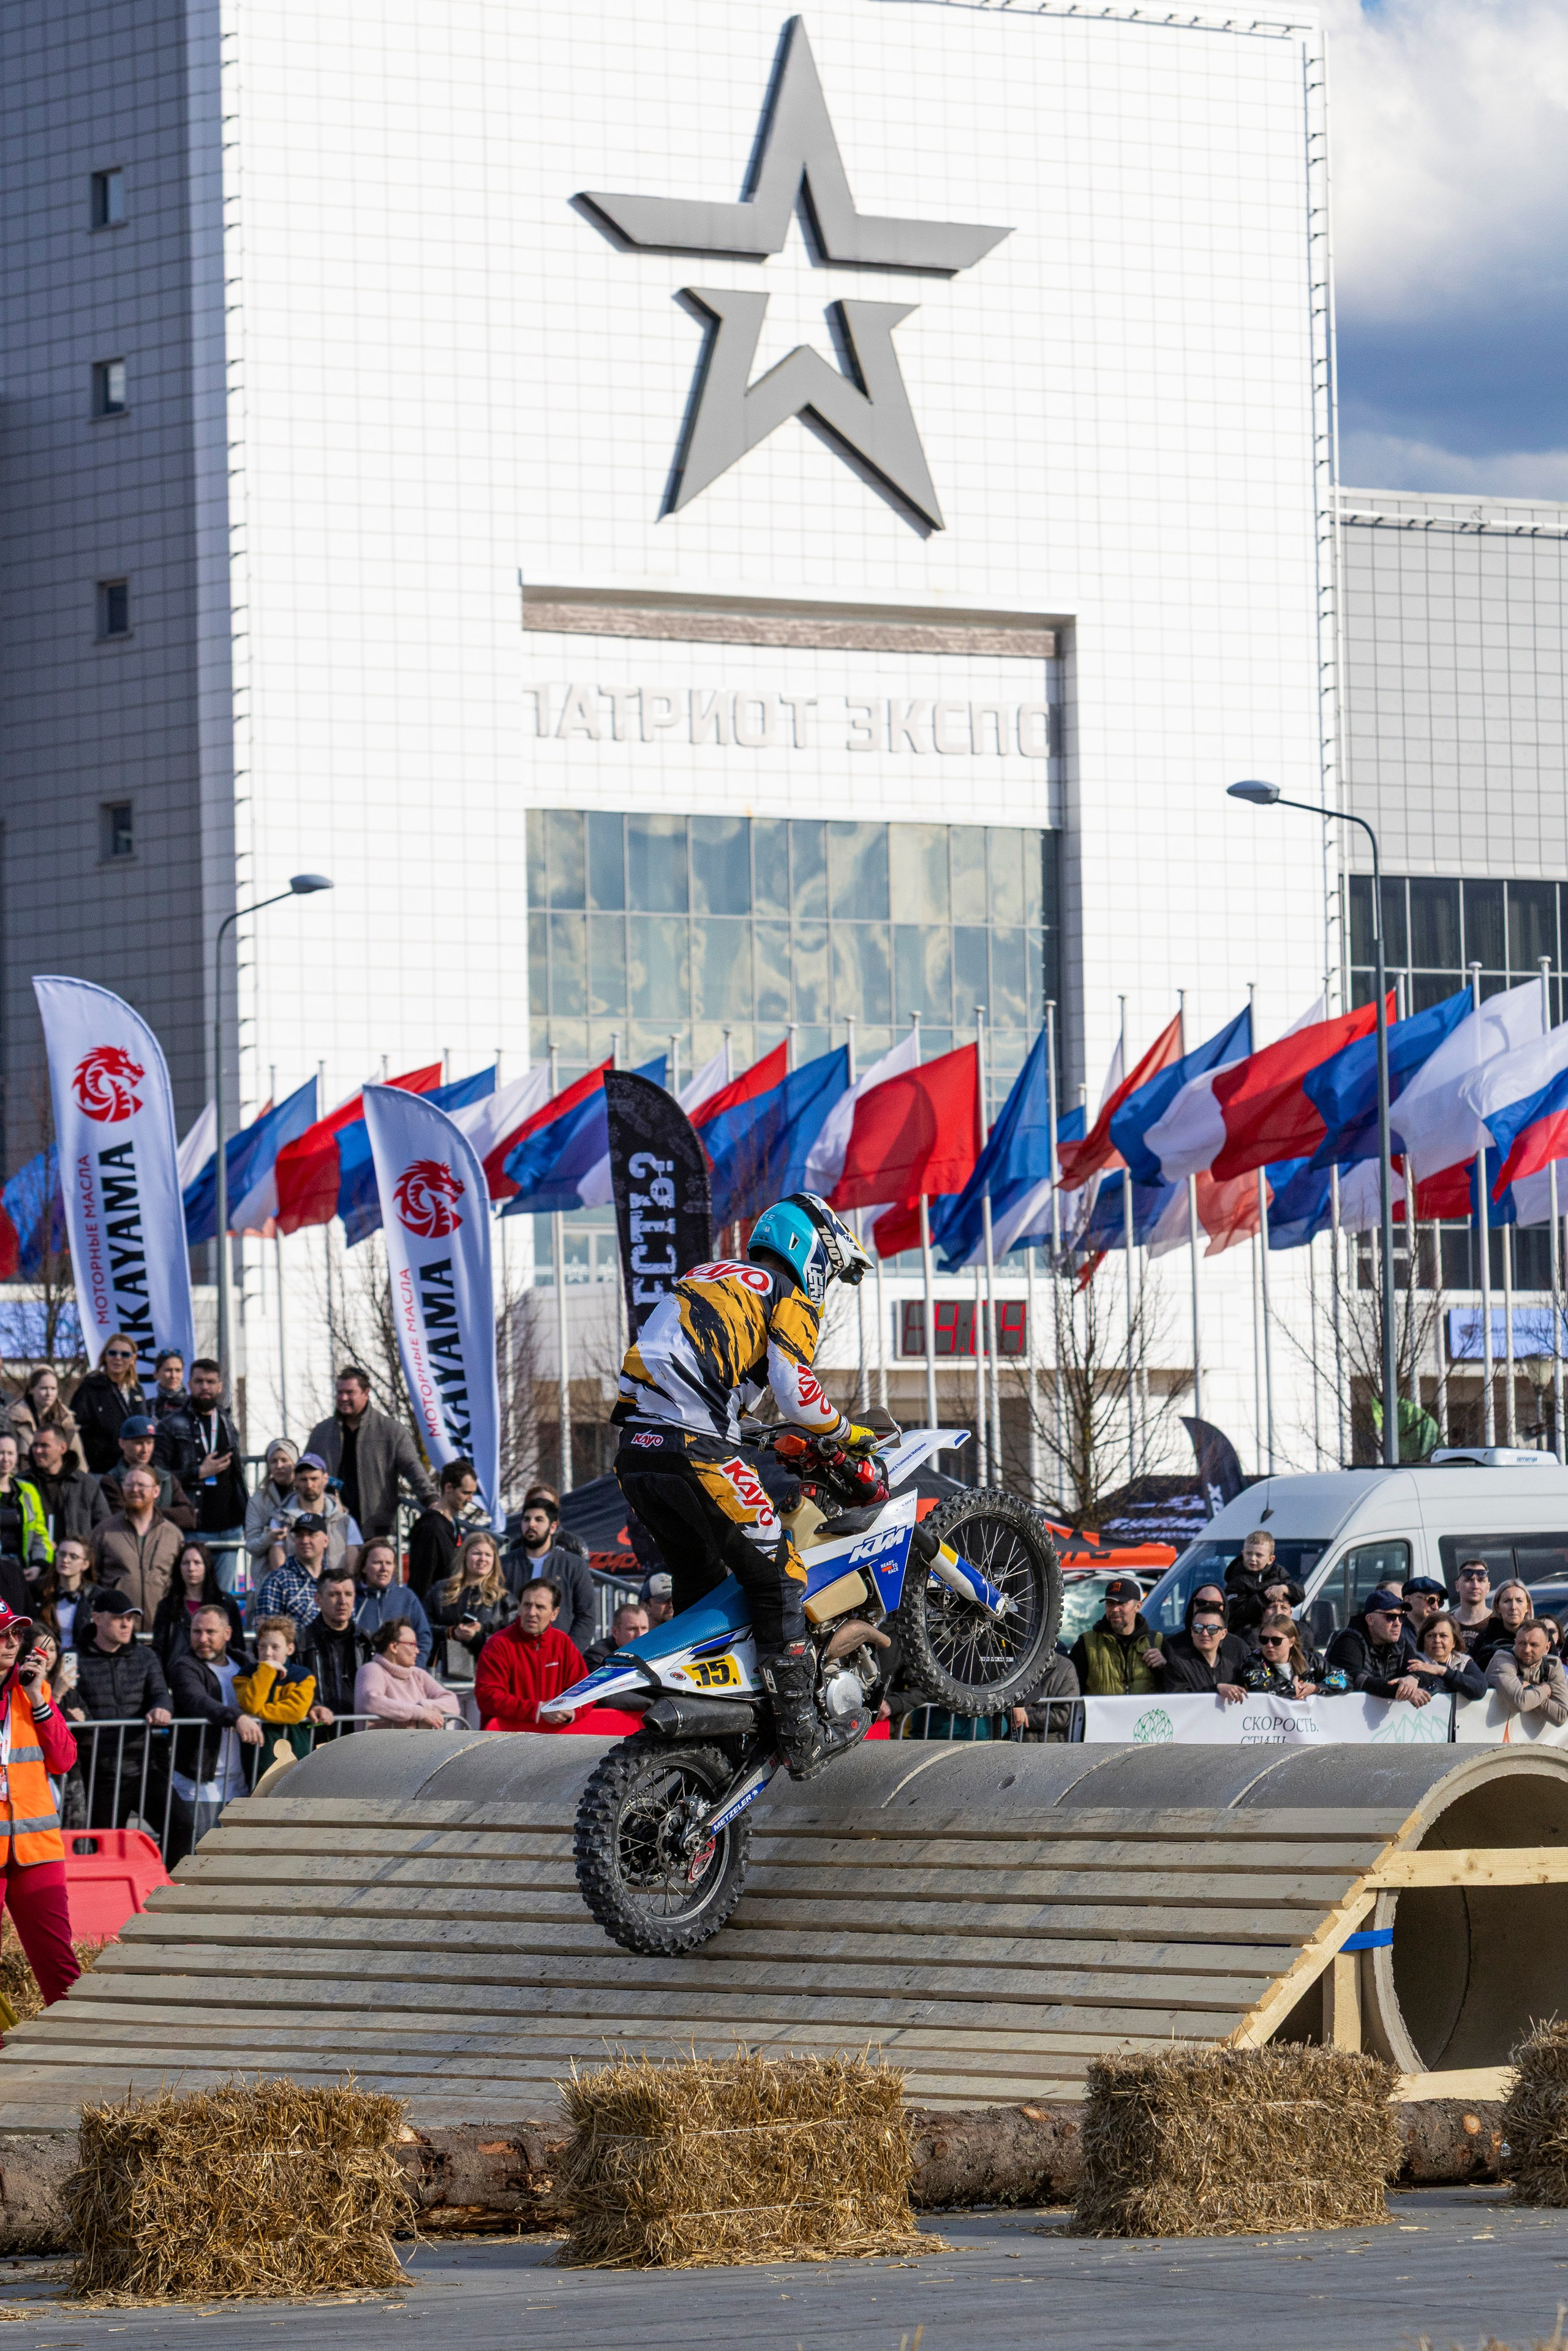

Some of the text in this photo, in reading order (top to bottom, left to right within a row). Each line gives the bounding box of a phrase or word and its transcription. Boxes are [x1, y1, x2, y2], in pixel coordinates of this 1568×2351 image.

[845, 696, 1050, 758] ЭКСПО
[77, 1154, 110, 1325] МОТОРНЫЕ МАСЛА
[817, 1225, 845, 1275] 100%
[399, 1267, 441, 1438] МОТОРНЫЕ МАСЛА
[419, 1257, 483, 1495] KAYAMA
[631, 1431, 663, 1447] KAYO
[722, 1460, 774, 1526] KAYO
[848, 1527, 906, 1564] KTM
[880, 1560, 894, 1569] READY
[692, 1658, 730, 1686] 15
[1242, 1716, 1319, 1732] СКОРОСТЬ.
[713, 1794, 752, 1832] METZELER
